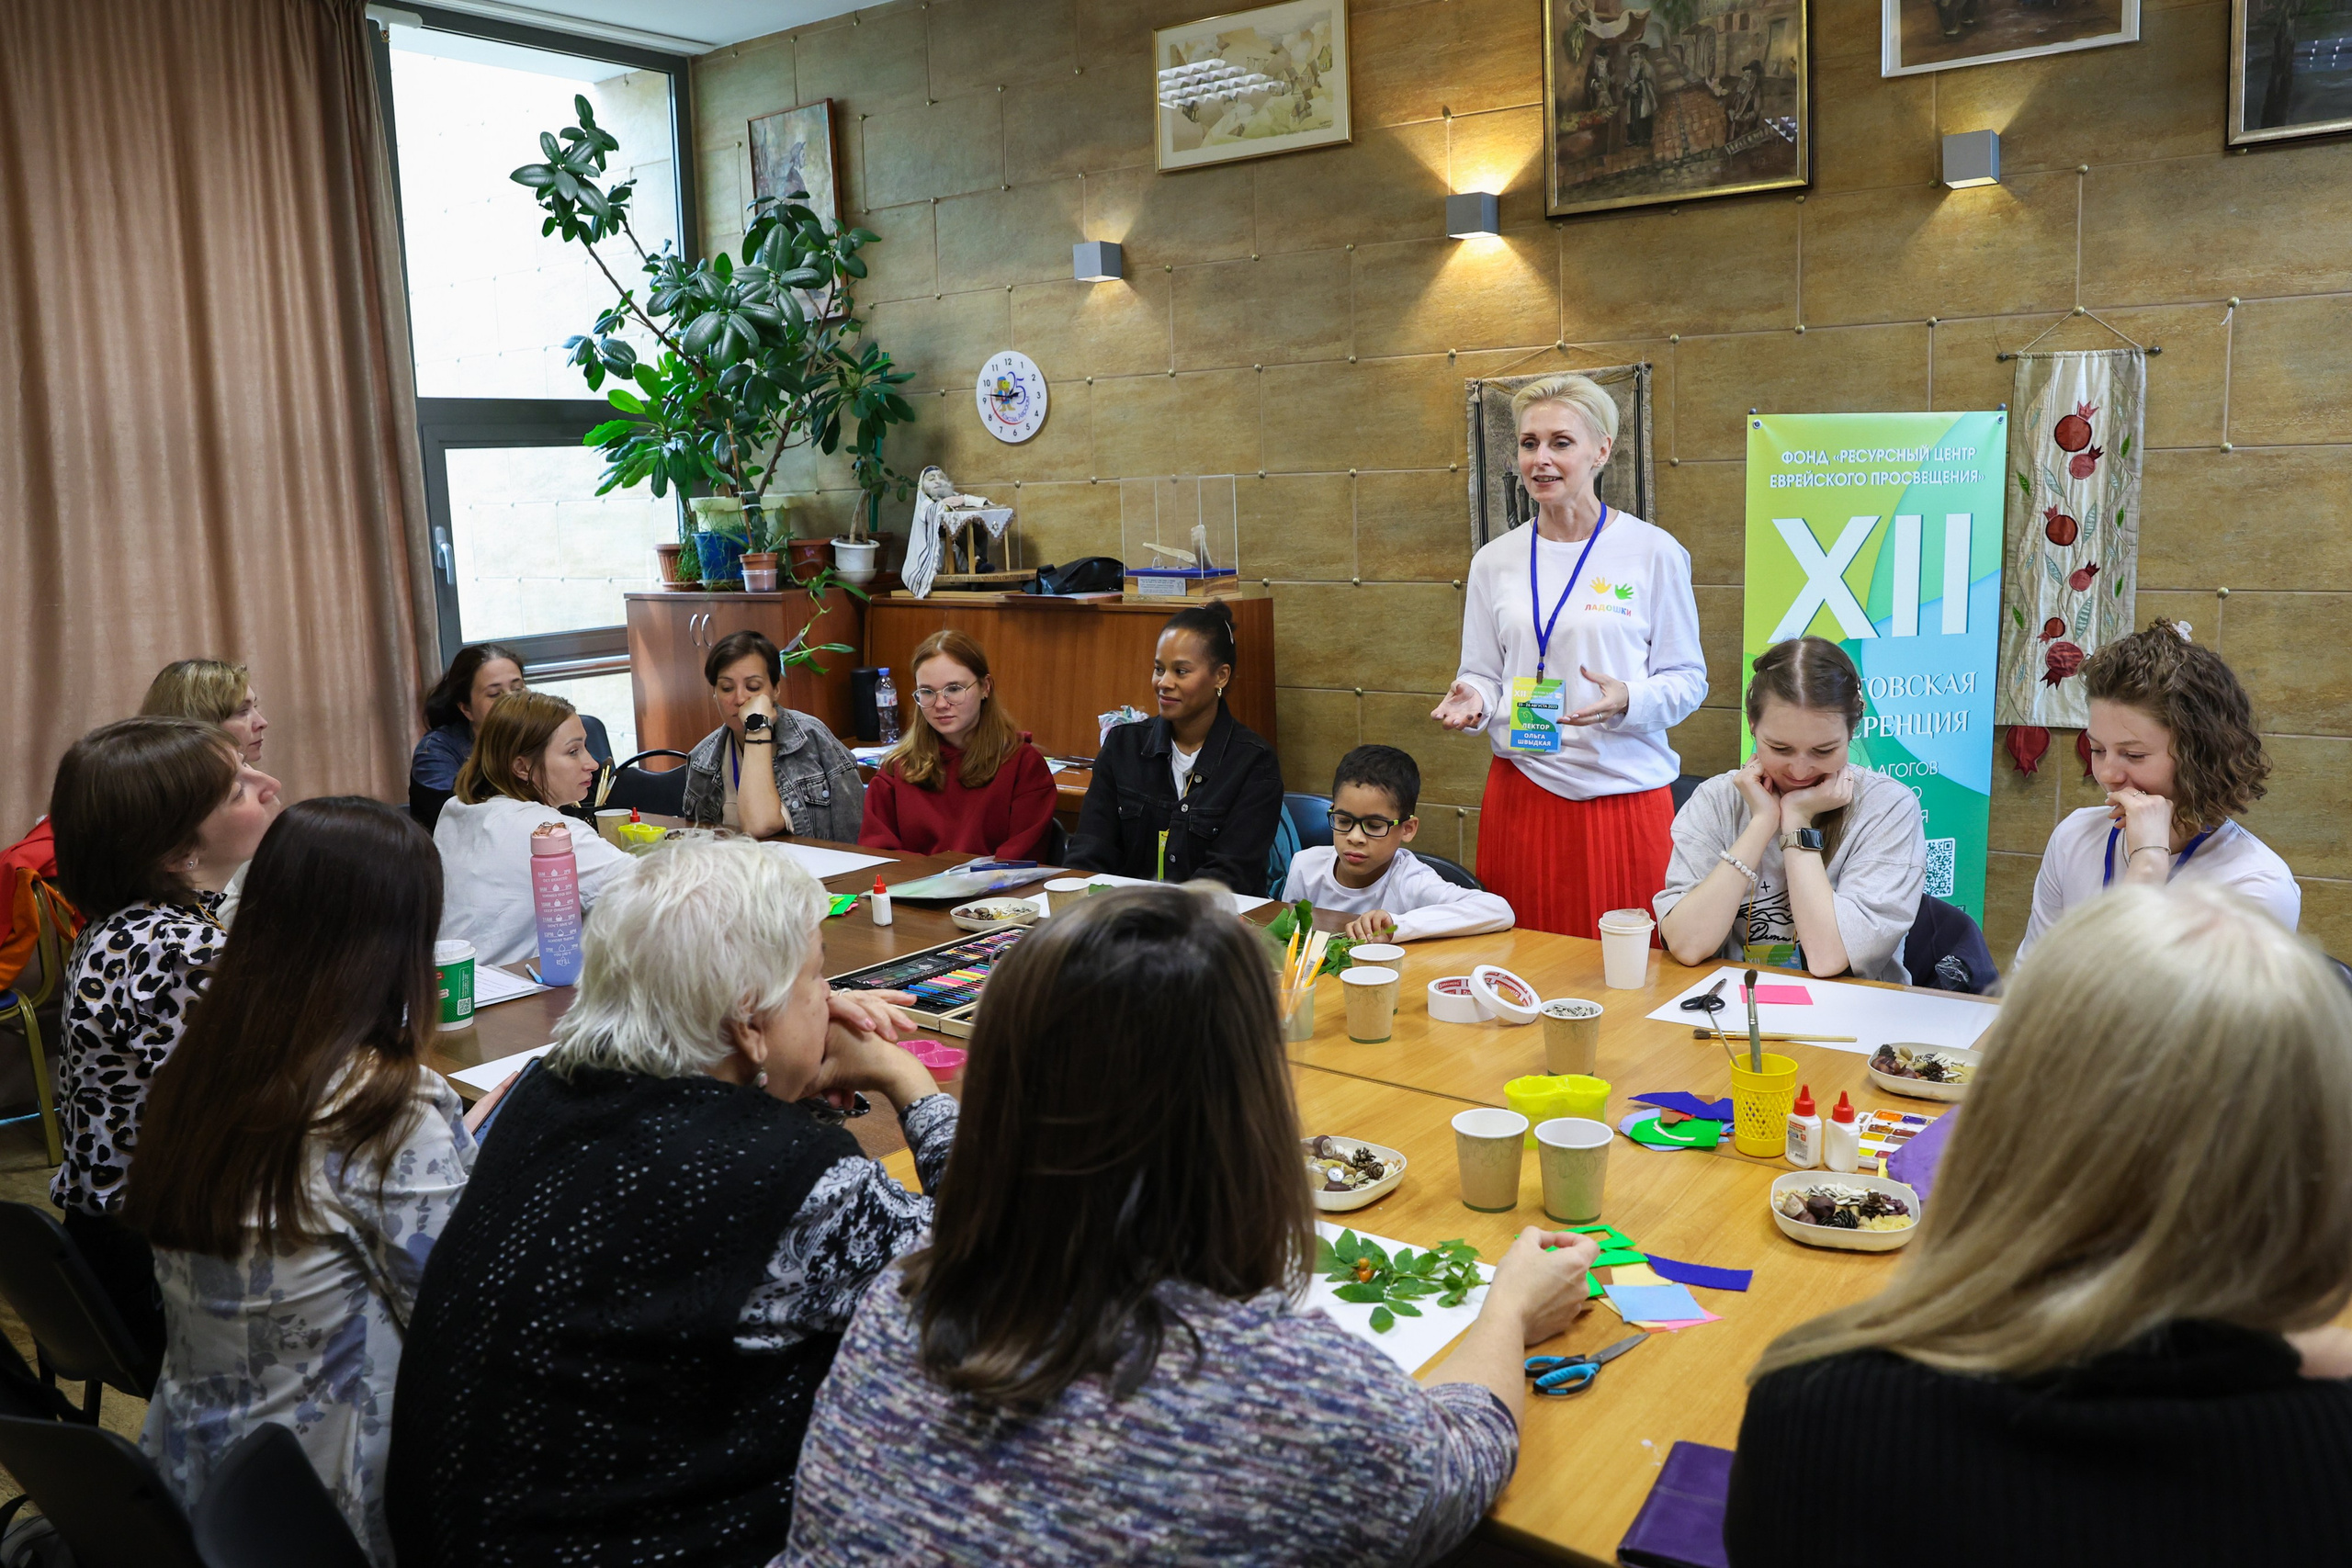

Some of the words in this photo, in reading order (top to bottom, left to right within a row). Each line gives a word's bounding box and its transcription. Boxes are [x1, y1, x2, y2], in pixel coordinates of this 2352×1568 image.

[1007, 371, 1026, 404] 25
[1781, 450, 1830, 466] ФОНД
[1833, 446, 1930, 464] «РЕСУРСНЫЙ
[1935, 447, 1976, 464] ЦЕНТР
[1770, 470, 1867, 489] ЕВРЕЙСКОГО
[1871, 470, 1985, 487] ПРОСВЕЩЕНИЯ»
[1768, 513, 1973, 644] XII
[1585, 604, 1632, 617] ЛАДОШКИ
[1860, 671, 1978, 700] ОВСКАЯ
[1852, 710, 1971, 739] РЕНЦИЯ
[1866, 761, 1939, 777] АГОГОВ
